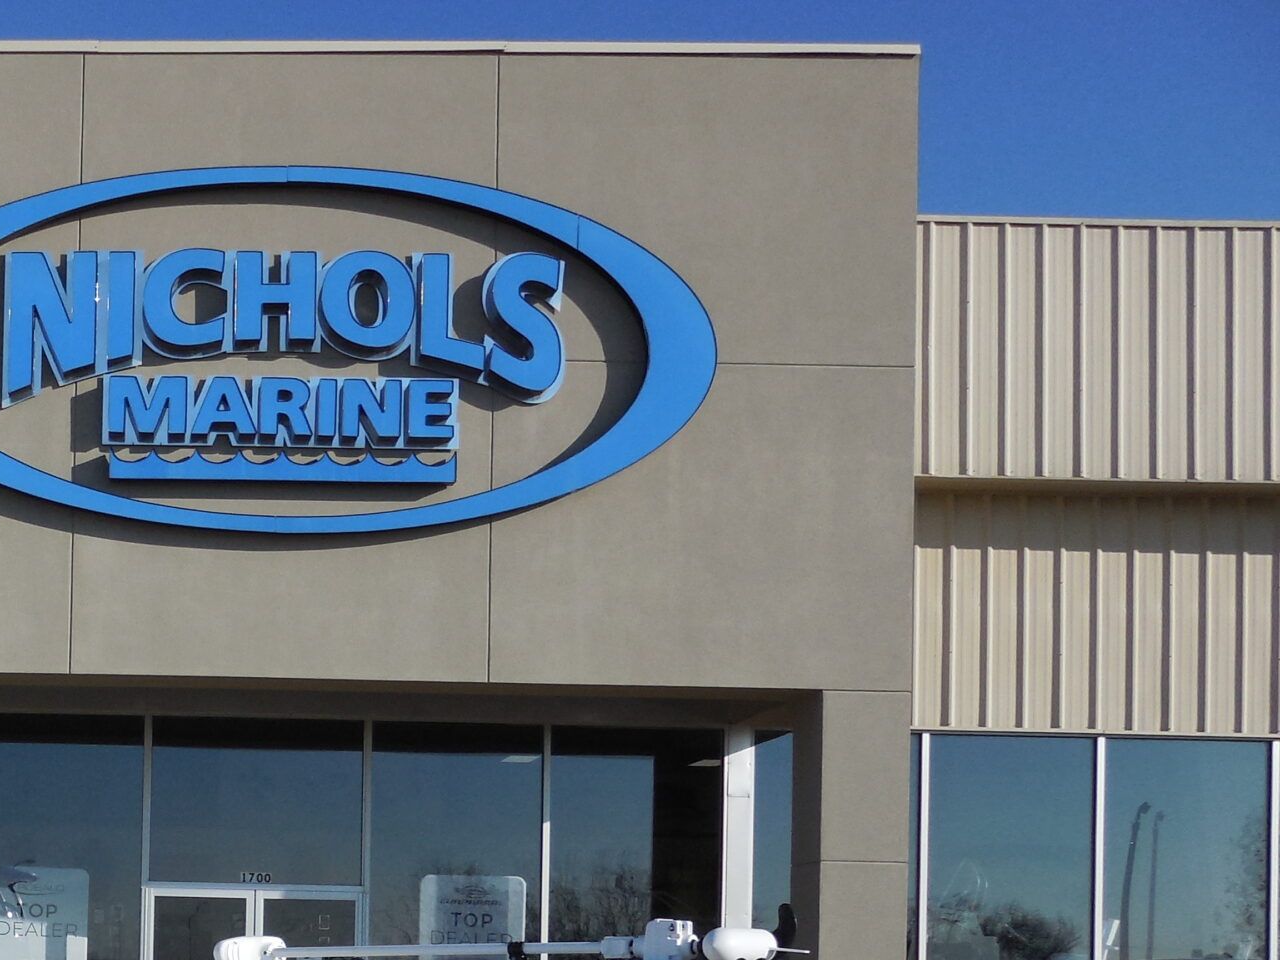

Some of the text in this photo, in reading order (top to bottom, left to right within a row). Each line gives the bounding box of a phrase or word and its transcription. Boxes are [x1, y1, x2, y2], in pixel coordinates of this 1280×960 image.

[2, 248, 565, 405] NICHOLS
[103, 375, 460, 449] MARINE
[242, 872, 271, 883] 1700
[17, 903, 58, 918] TOP
[451, 912, 493, 928] TOP
